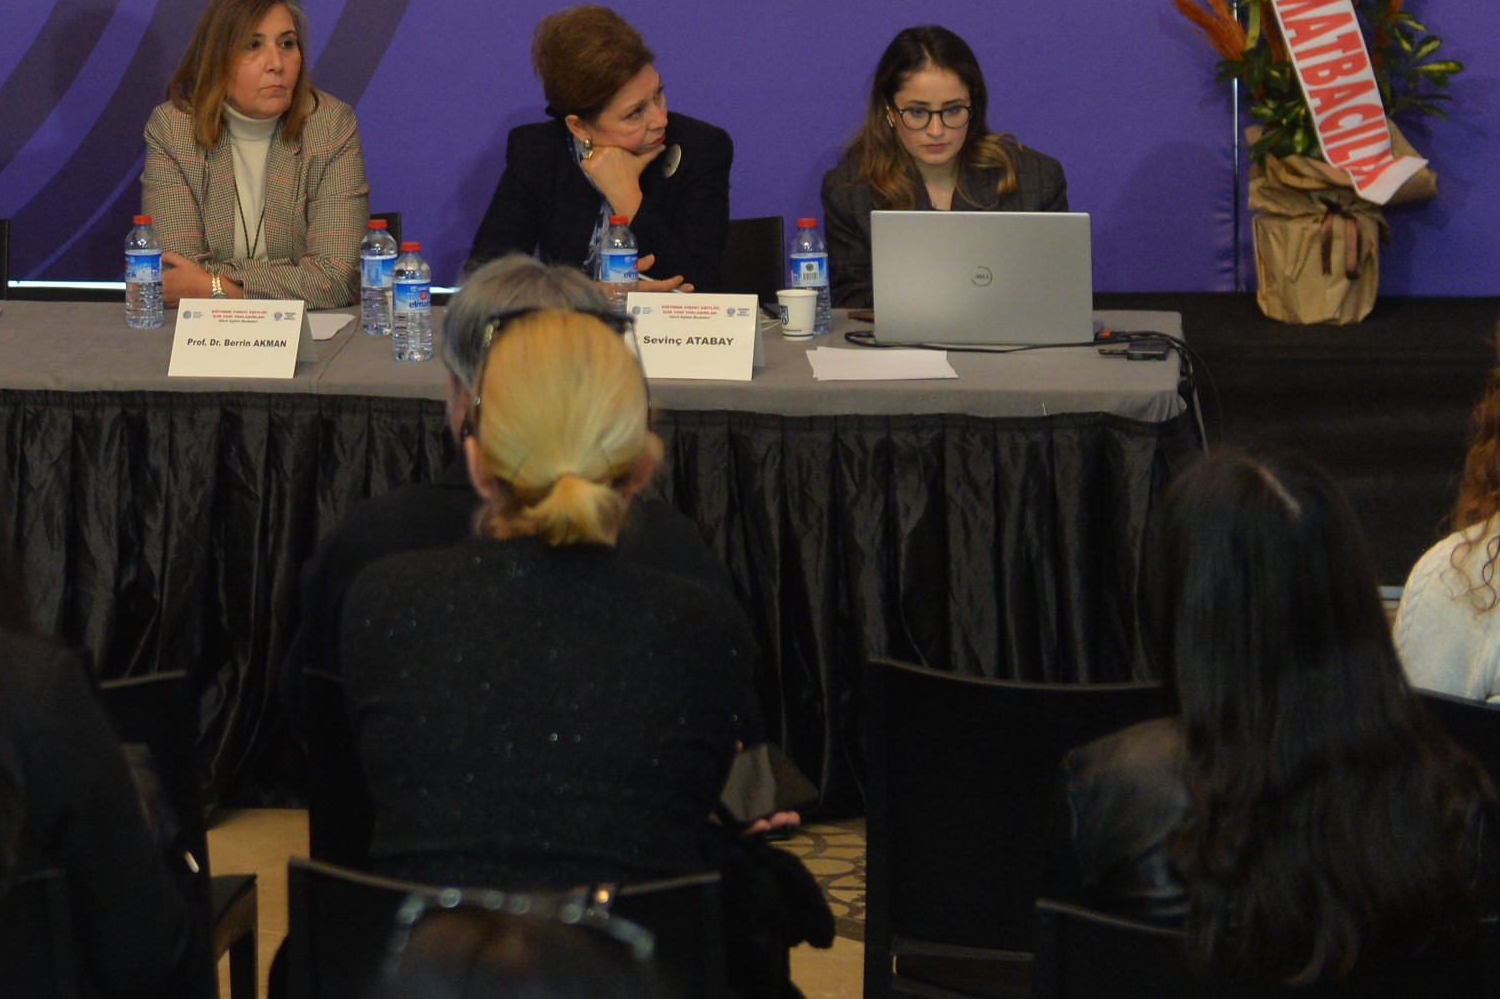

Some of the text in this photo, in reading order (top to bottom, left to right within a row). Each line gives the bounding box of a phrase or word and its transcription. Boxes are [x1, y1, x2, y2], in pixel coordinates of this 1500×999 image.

[187, 337, 287, 348] Prof. Dr. Berrin AKMAN
[643, 335, 734, 346] Sevinç ATABAY
